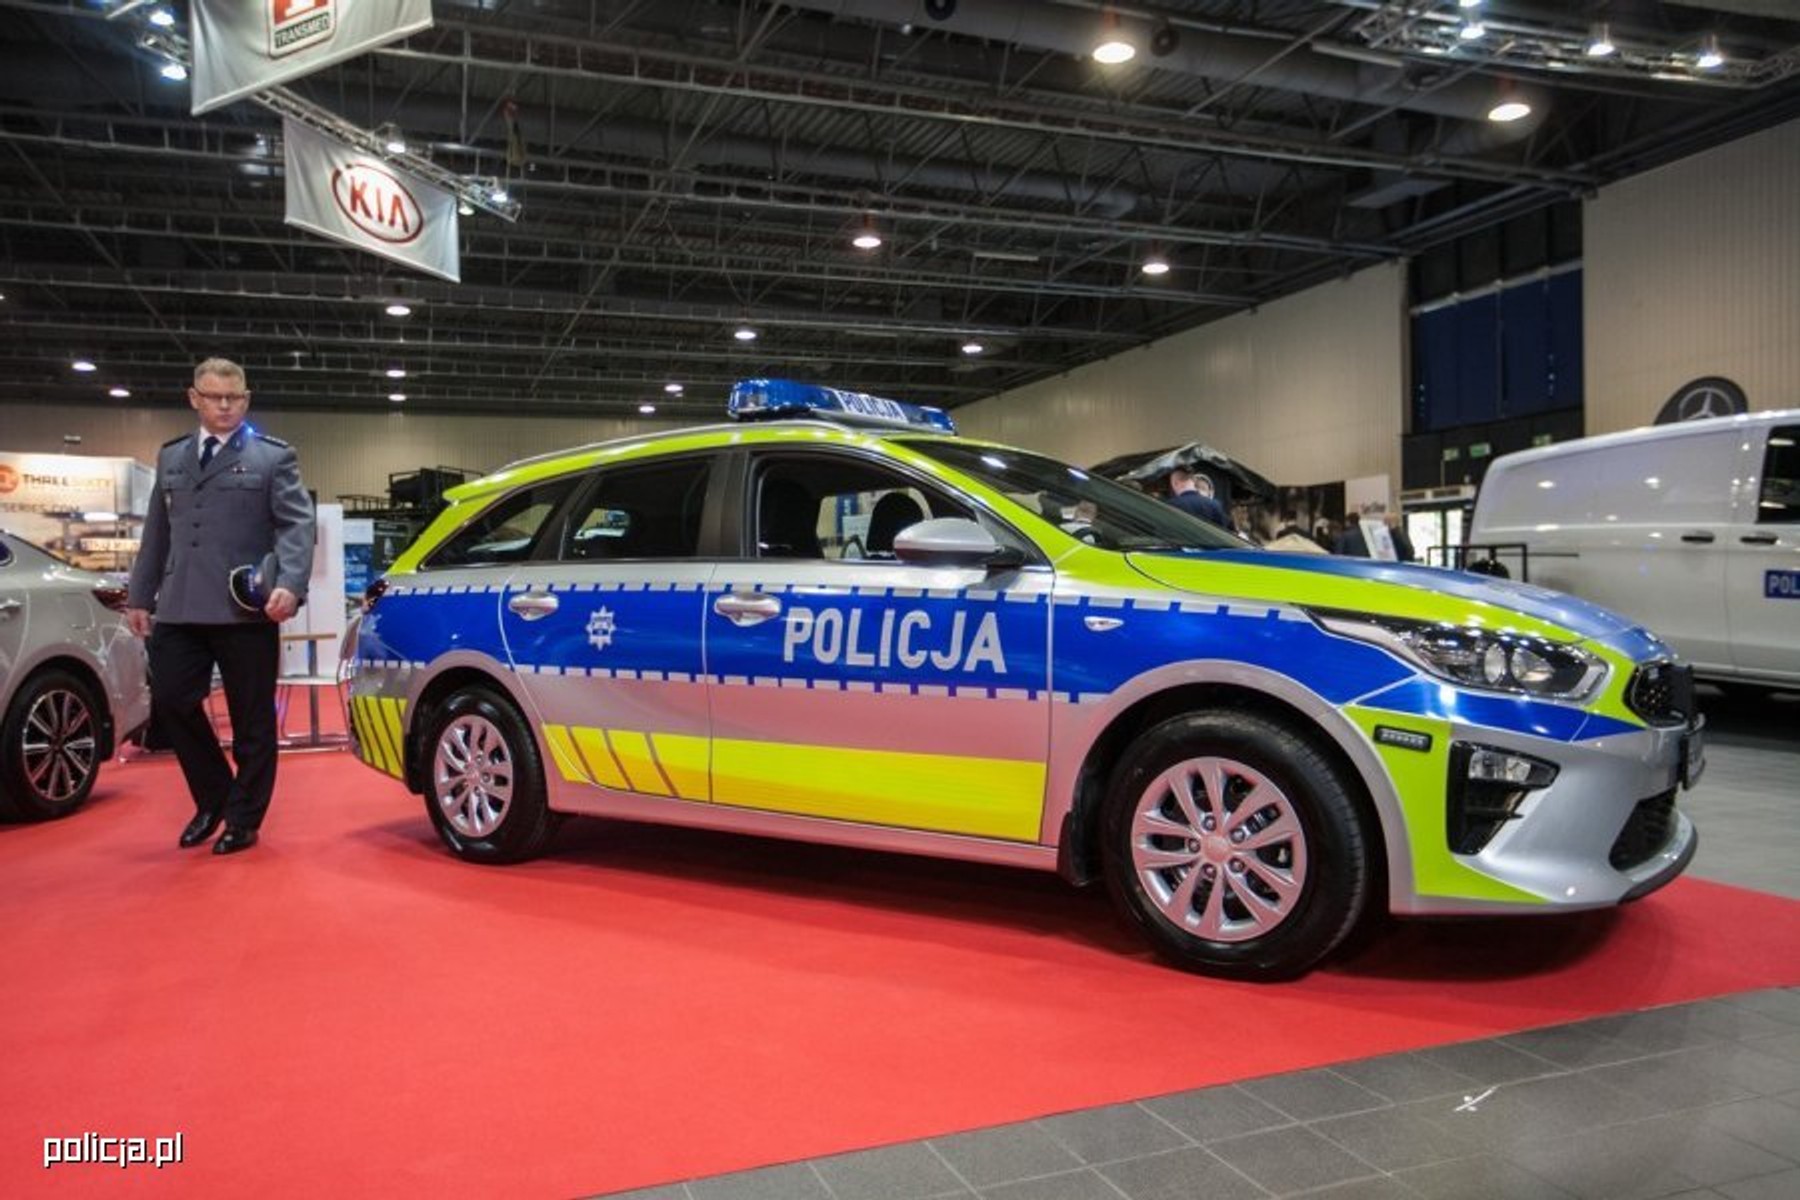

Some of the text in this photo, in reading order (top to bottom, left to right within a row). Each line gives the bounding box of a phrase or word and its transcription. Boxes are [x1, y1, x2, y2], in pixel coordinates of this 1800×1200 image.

[350, 175, 410, 234] KIA
[839, 390, 905, 418] POLICJA
[784, 606, 1007, 674] POLICJA
